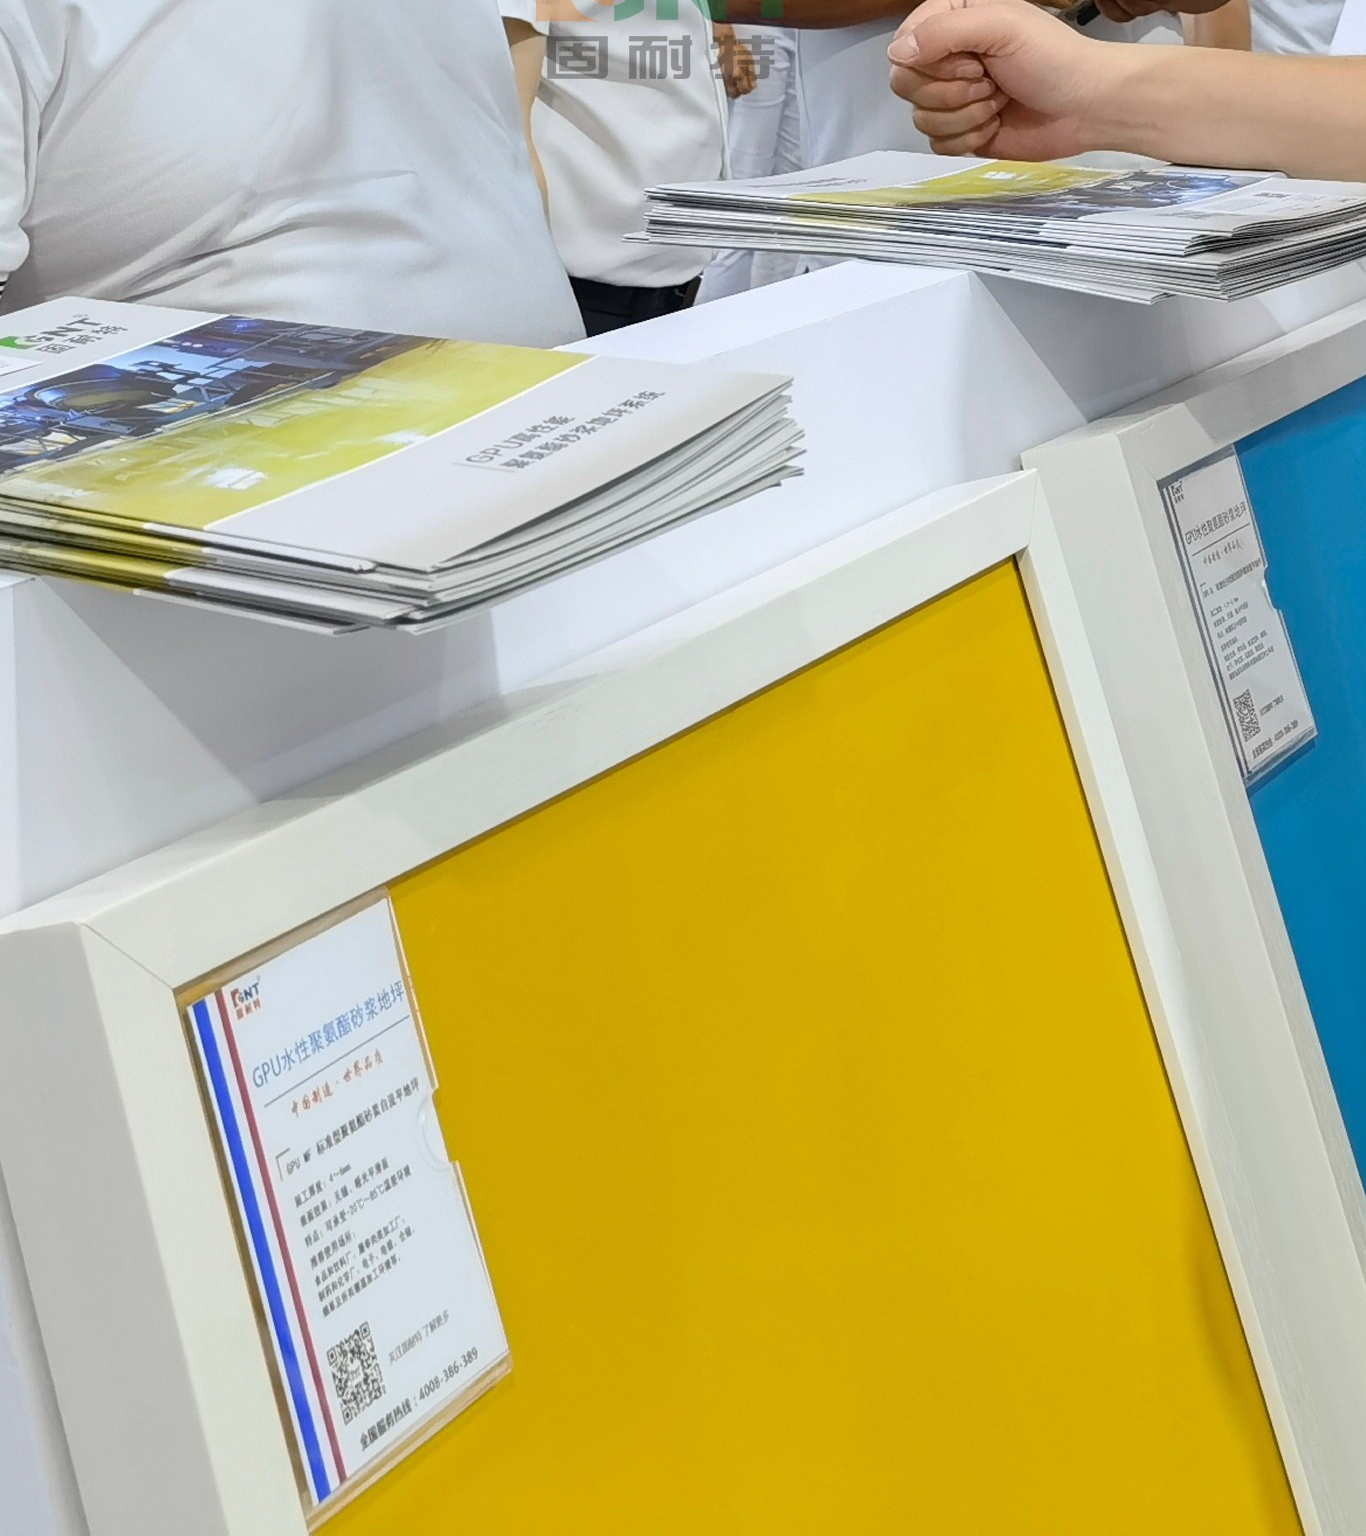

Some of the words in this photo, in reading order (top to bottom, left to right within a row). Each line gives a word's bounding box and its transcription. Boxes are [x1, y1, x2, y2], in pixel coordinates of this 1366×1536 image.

[252, 980, 405, 1089] GPU水性聚氨酯砂浆地坪
